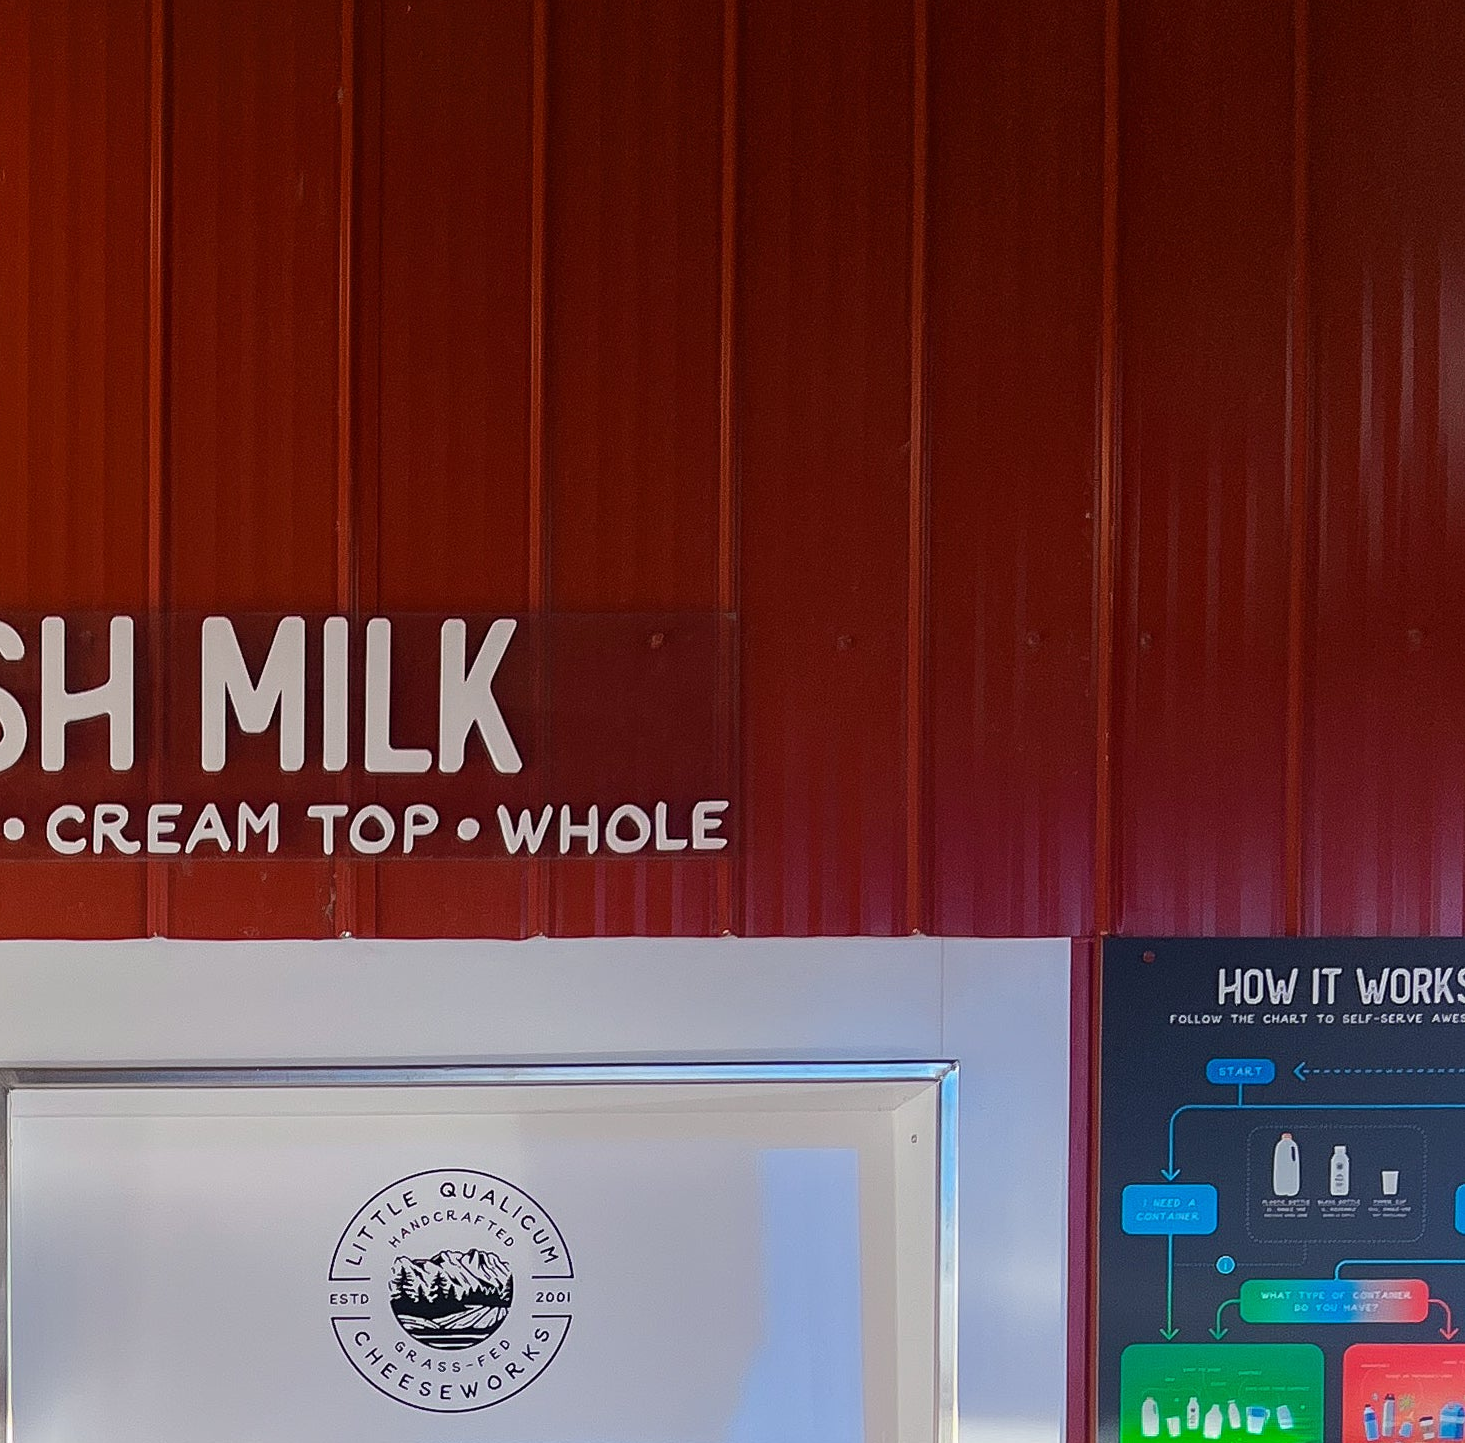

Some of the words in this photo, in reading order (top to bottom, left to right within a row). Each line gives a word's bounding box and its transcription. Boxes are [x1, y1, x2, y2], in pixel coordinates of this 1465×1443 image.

[200, 615, 523, 775] MILK
[46, 801, 280, 856] CREAM
[306, 803, 441, 856] TOP
[497, 800, 730, 856] WHOLE
[1217, 967, 1299, 1006] HOW
[1311, 967, 1342, 1005] IT
[1169, 1013, 1223, 1025] FOLLOW
[1230, 1013, 1255, 1025] THE
[1262, 1013, 1308, 1025] CHART
[1316, 1013, 1335, 1025] TO
[1342, 1013, 1423, 1025] SELF-SERVE
[1217, 1066, 1264, 1077] START
[1152, 1199, 1181, 1208] NEED
[1188, 1199, 1196, 1208] A
[345, 1190, 418, 1266] LITTLE
[439, 1181, 559, 1264] QUALICUM
[1136, 1212, 1200, 1221] CONTAINER
[388, 1209, 515, 1249] HANDCRAFTED
[329, 1293, 369, 1305] ESTD
[535, 1291, 571, 1303] 2001
[1260, 1291, 1291, 1300] WHAT
[1299, 1291, 1325, 1300] TYPE
[1333, 1291, 1344, 1300] OF
[1352, 1291, 1412, 1300] CONTAINER
[1294, 1304, 1309, 1312] DO
[1316, 1304, 1338, 1312] YOU
[354, 1327, 550, 1400] CHEESEWORKS
[394, 1340, 511, 1373] GRASS-FED
